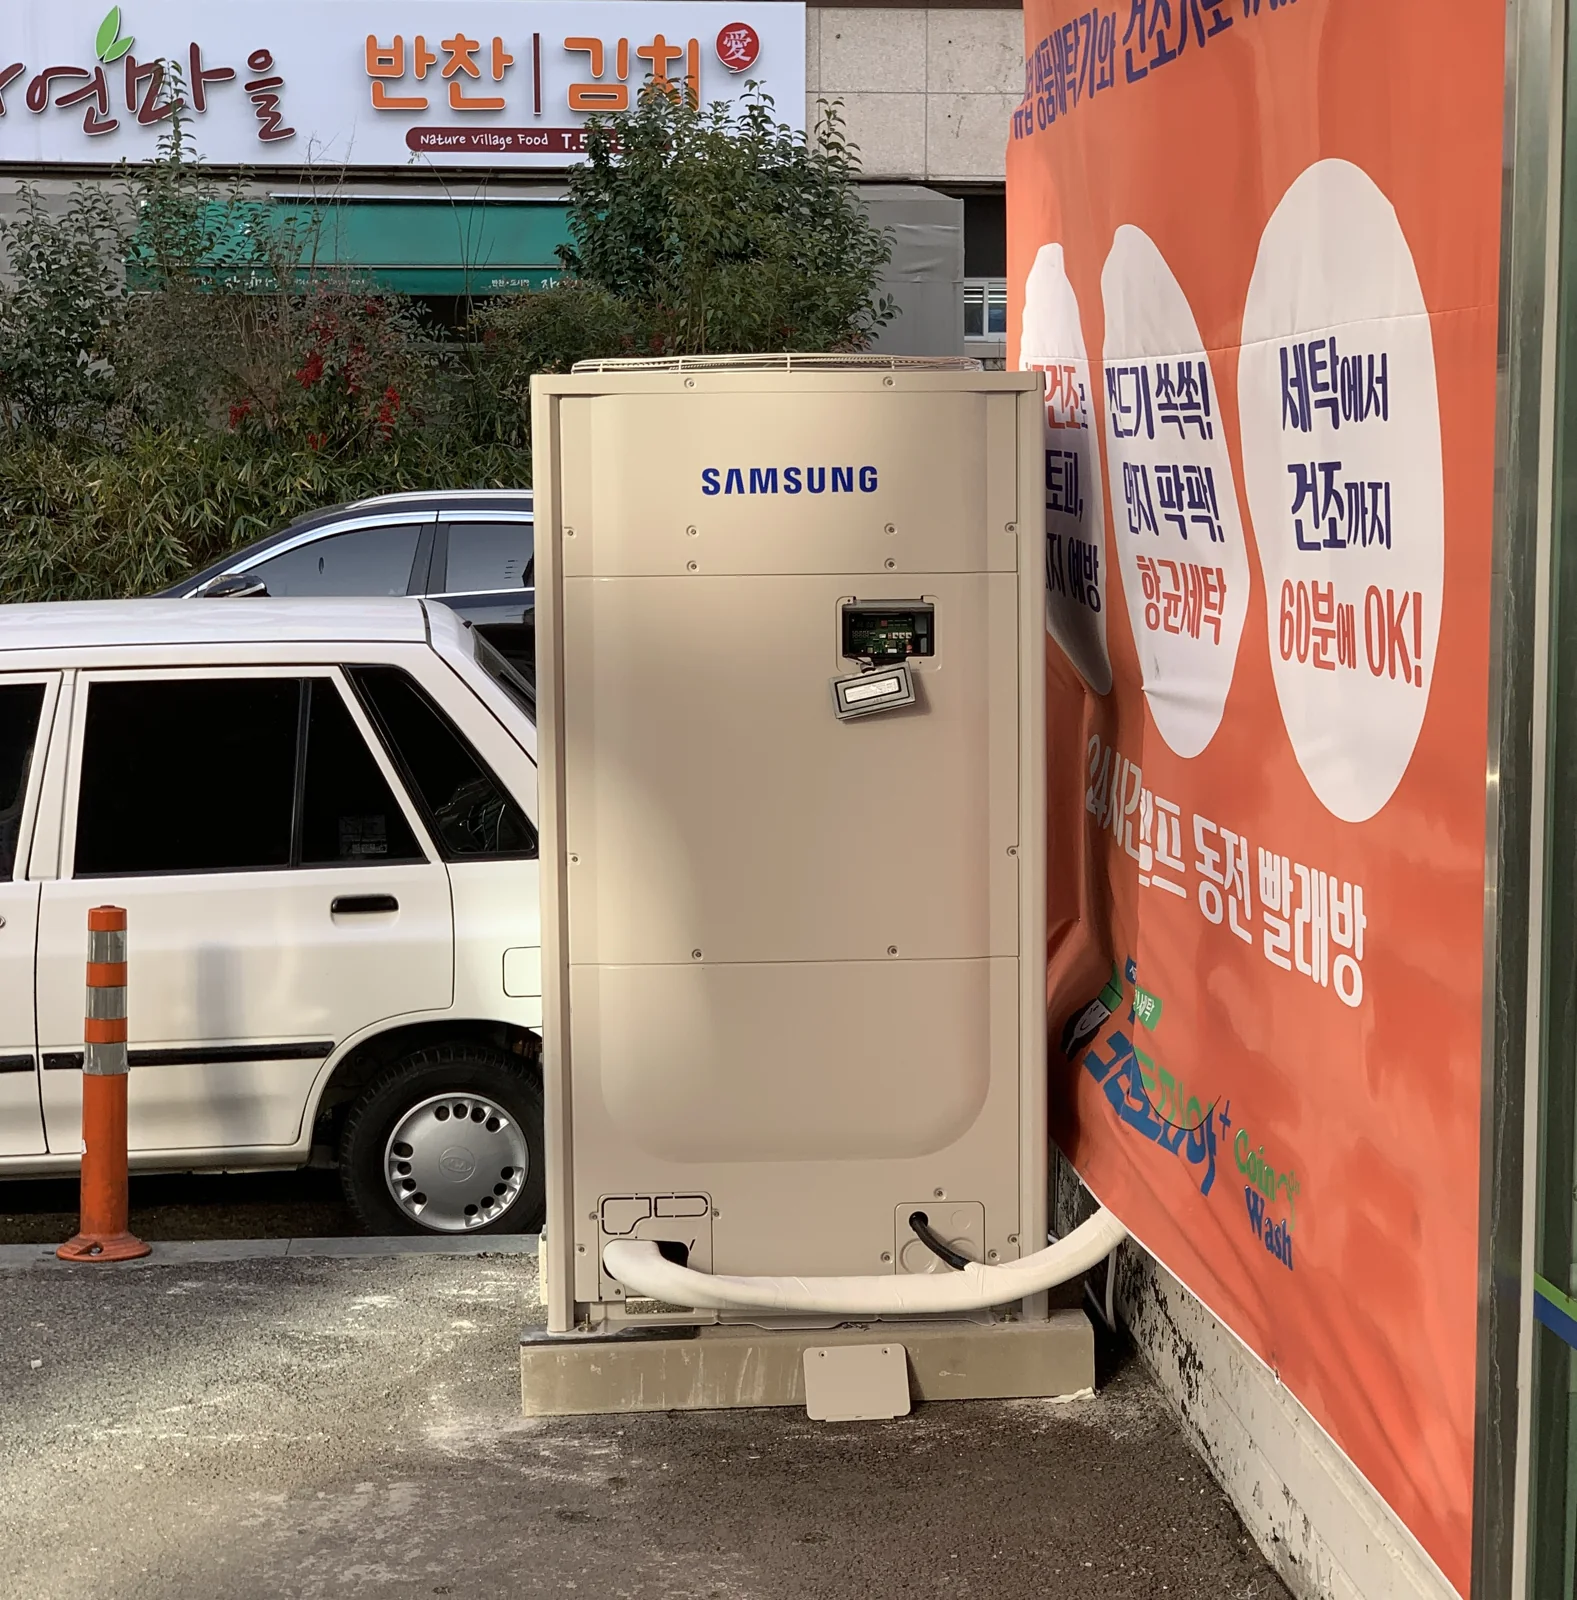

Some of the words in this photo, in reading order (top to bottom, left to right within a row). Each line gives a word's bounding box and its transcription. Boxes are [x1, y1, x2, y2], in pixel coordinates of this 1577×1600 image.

[365, 33, 515, 111] 반찬
[563, 34, 700, 112] 김치
[723, 29, 752, 62] 愛
[0, 42, 296, 142] 연마을
[420, 134, 466, 147] Nature
[471, 133, 512, 150] Village
[518, 133, 549, 147] Food
[1155, 361, 1213, 440] 쏙쏙!
[1280, 336, 1388, 433] 세탁에서
[701, 466, 878, 495] SAMSUNG
[1123, 461, 1160, 536] 먼지
[1155, 464, 1225, 543] 팍팍!
[1287, 461, 1391, 551] 건조까지
[1136, 555, 1226, 646] 항균세탁
[1280, 579, 1356, 671] 60분에
[1364, 585, 1422, 688] OK!
[1193, 813, 1252, 944] 동전
[1258, 846, 1367, 1008] 빨래방
[1234, 1128, 1275, 1201] Coin
[1245, 1184, 1293, 1271] Wash
